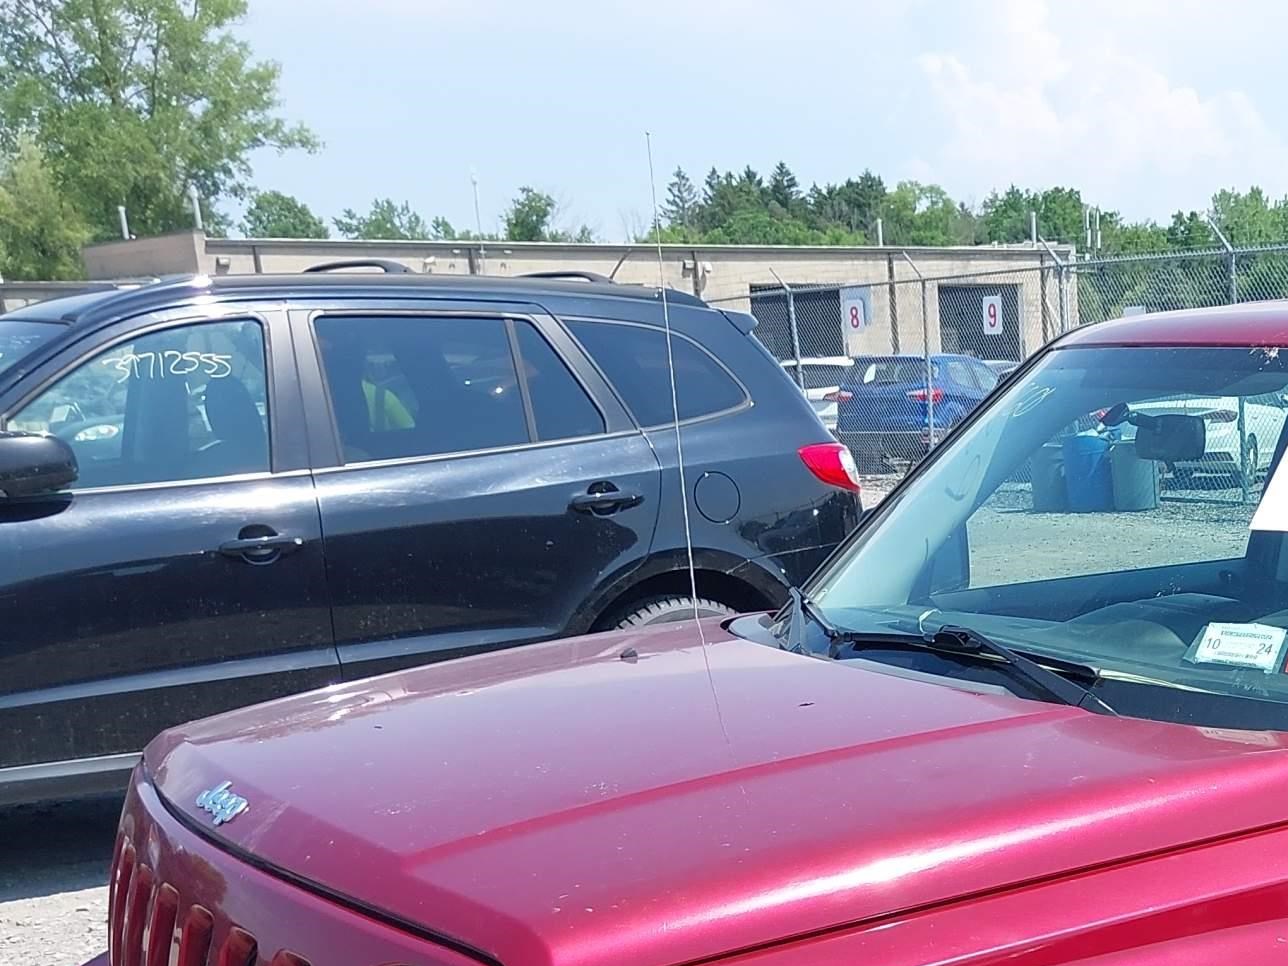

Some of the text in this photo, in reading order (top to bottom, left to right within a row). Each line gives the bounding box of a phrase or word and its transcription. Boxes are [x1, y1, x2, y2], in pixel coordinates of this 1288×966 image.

[849, 306, 860, 328] 8
[987, 303, 997, 328] 9
[102, 350, 232, 383] 39712555
[1206, 637, 1221, 650] 10
[1256, 643, 1273, 656] 24
